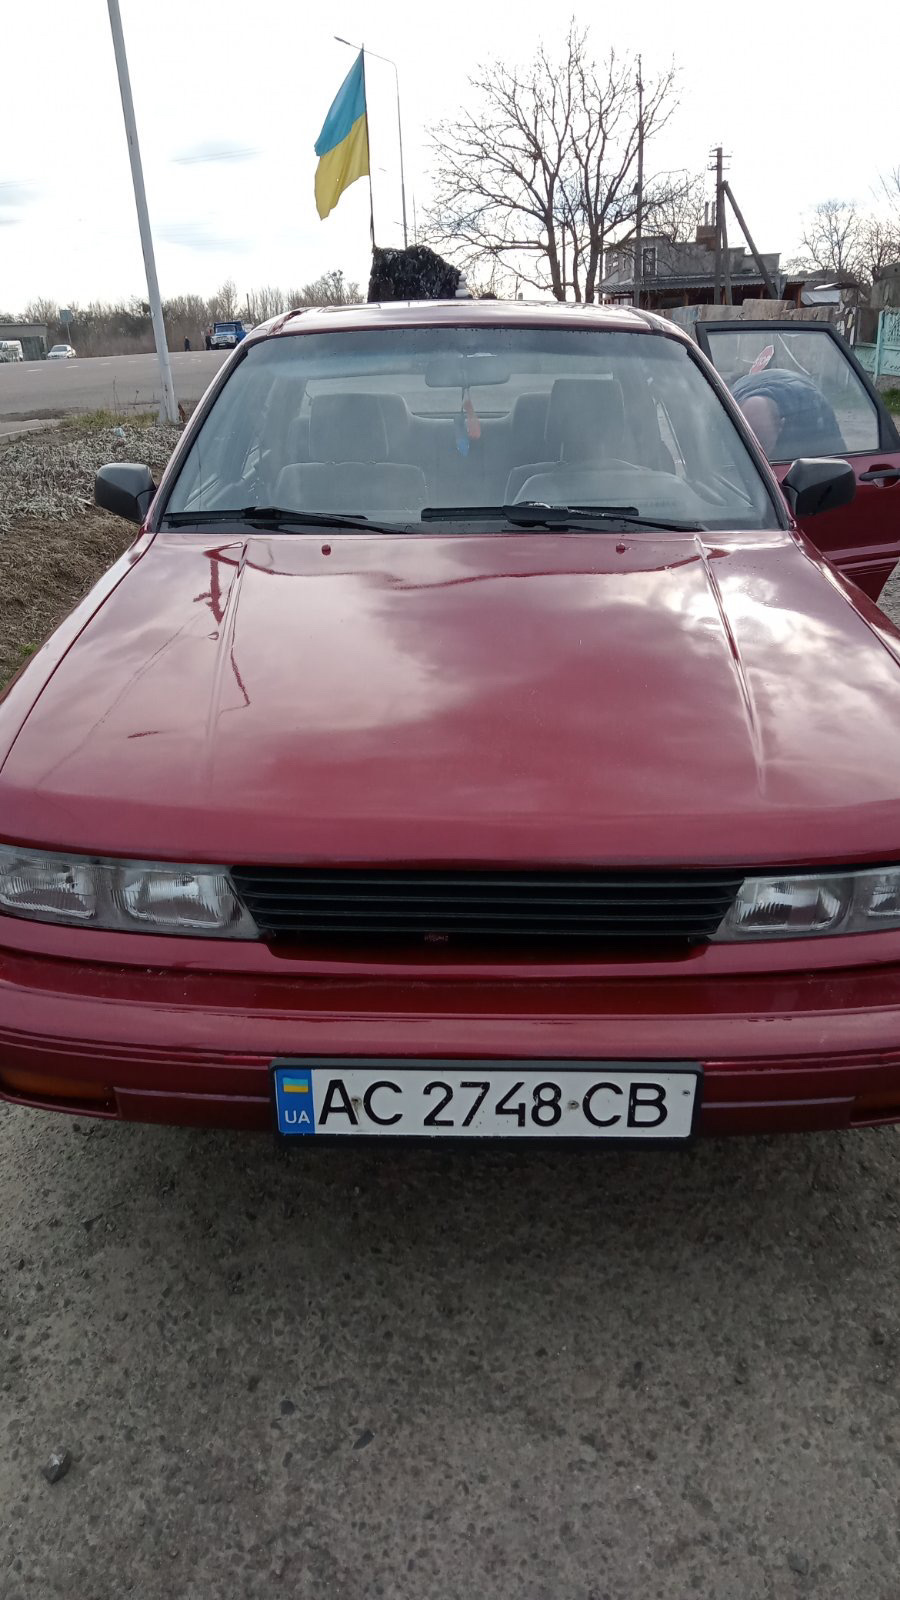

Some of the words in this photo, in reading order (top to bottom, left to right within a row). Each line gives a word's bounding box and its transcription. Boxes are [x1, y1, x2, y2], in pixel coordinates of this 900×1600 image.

[284, 1110, 310, 1124] UA
[318, 1079, 403, 1126] AC
[422, 1081, 563, 1128] 2748
[582, 1082, 669, 1128] CB
